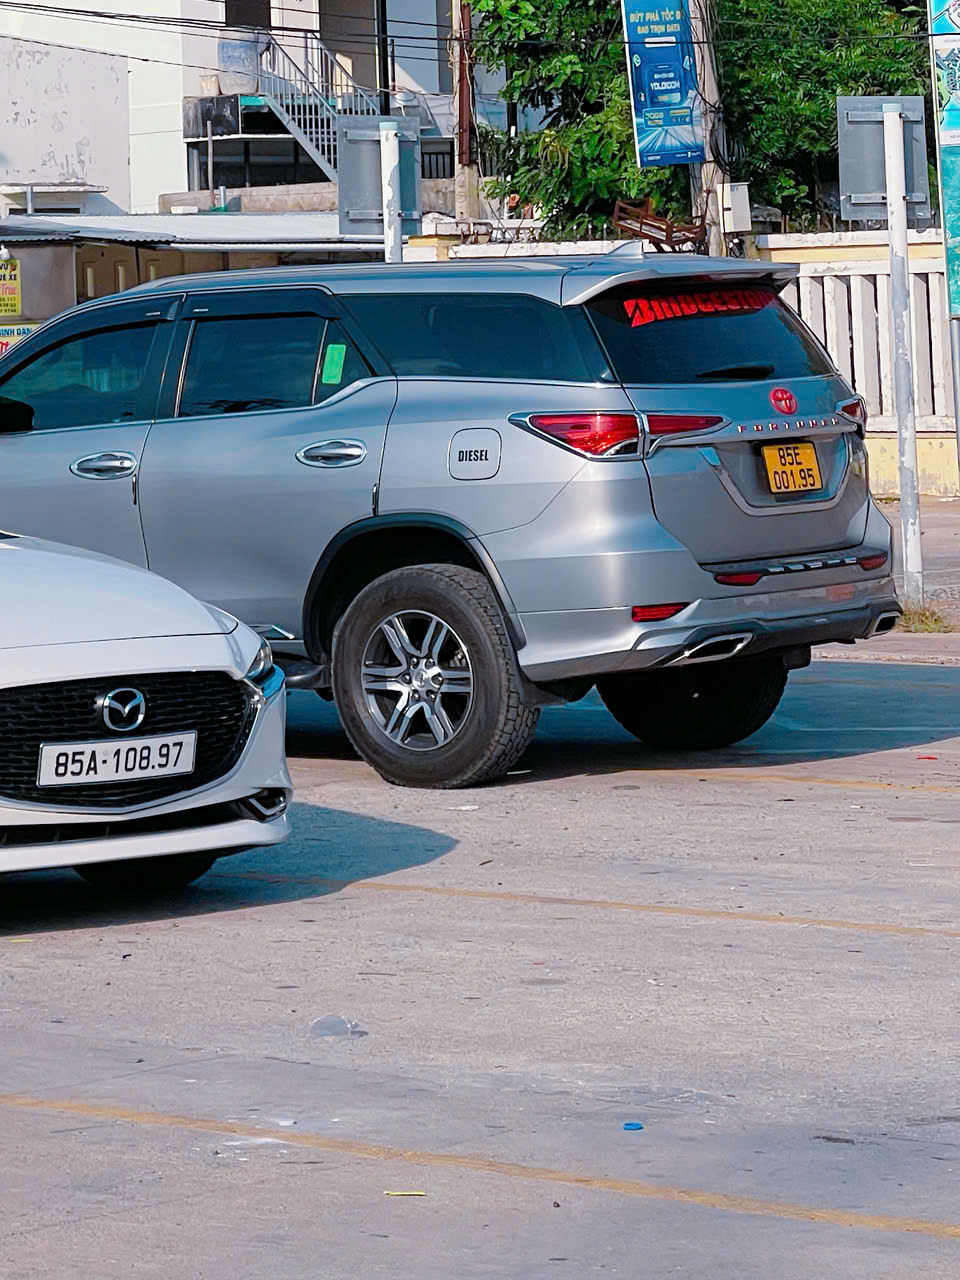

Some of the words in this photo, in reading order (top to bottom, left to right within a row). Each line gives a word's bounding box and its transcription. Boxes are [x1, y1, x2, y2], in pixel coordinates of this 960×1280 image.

[457, 449, 489, 462] DIESEL
[777, 445, 803, 467] 85E
[773, 467, 816, 490] 001.95
[54, 741, 184, 778] 85A-108.97
